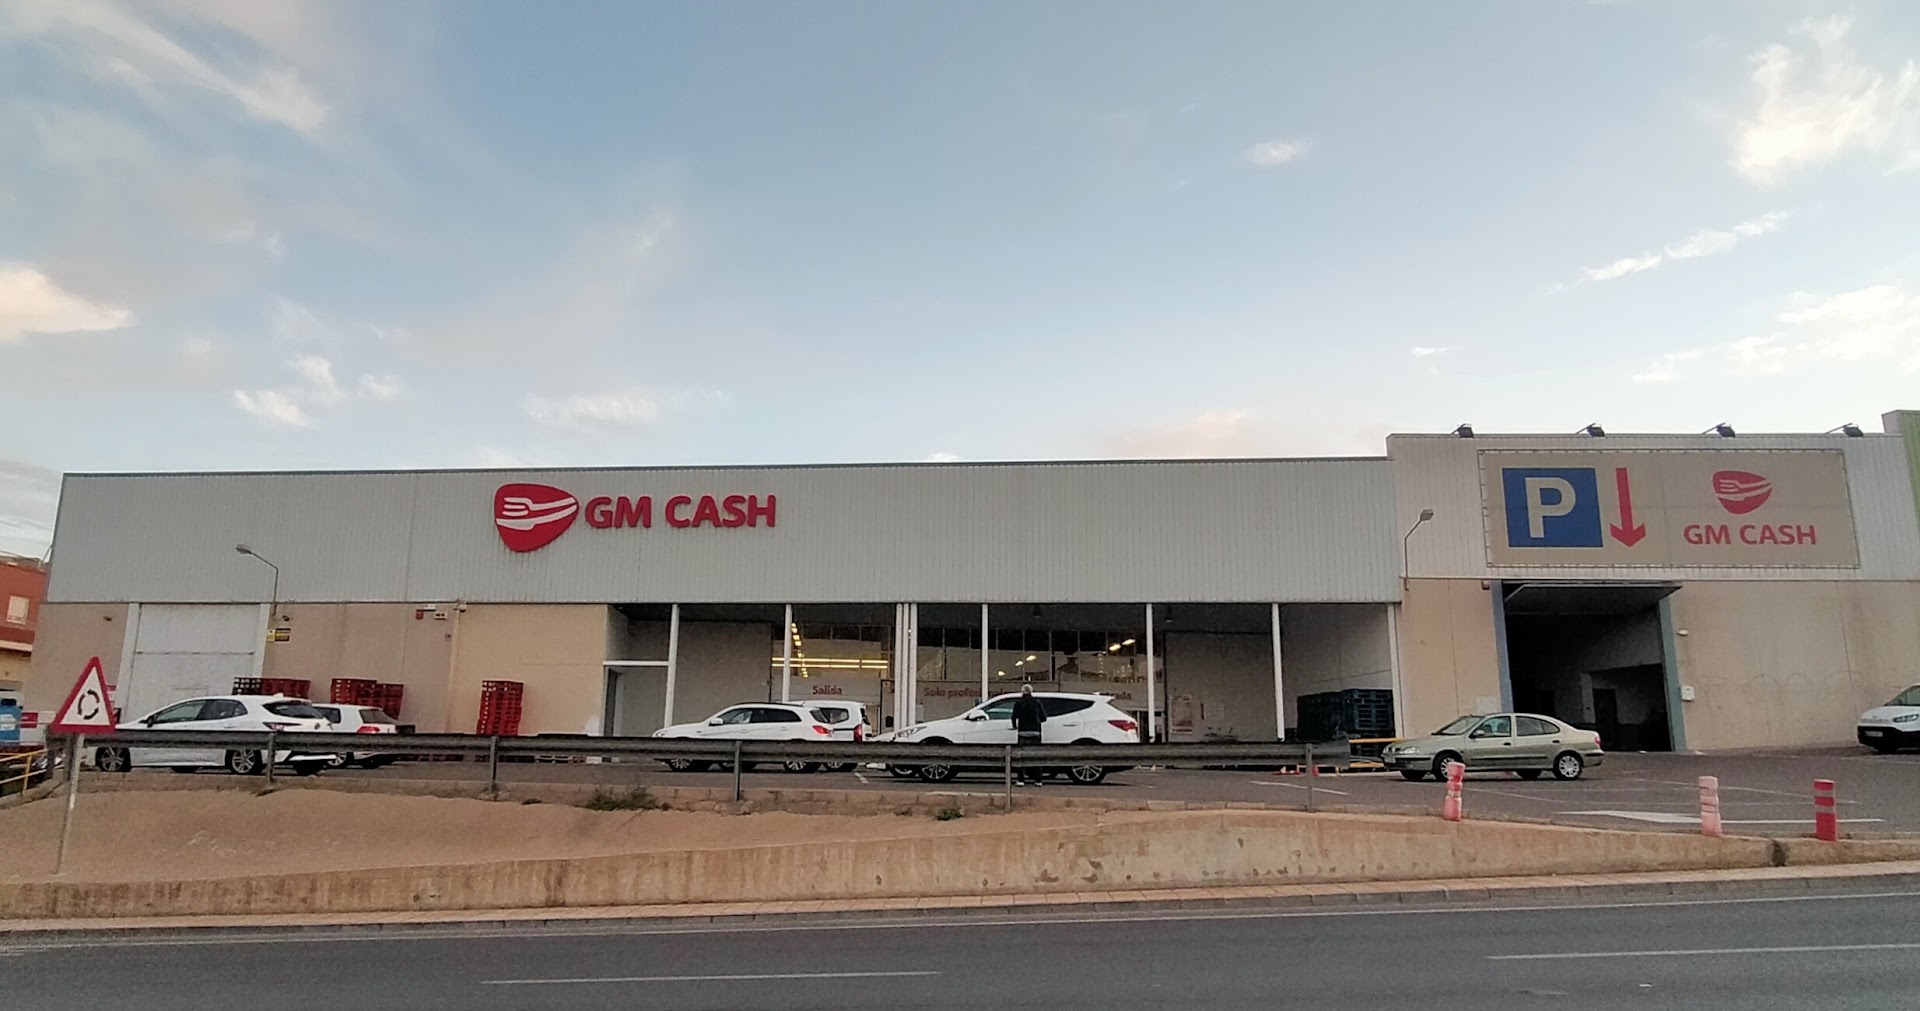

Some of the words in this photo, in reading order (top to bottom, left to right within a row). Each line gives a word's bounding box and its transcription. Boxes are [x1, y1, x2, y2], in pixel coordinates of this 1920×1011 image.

[584, 496, 651, 529] GM
[665, 494, 777, 528] CASH
[1525, 477, 1576, 538] P
[1683, 524, 1731, 545] GM
[1739, 524, 1817, 546] CASH
[812, 684, 842, 695] Salida
